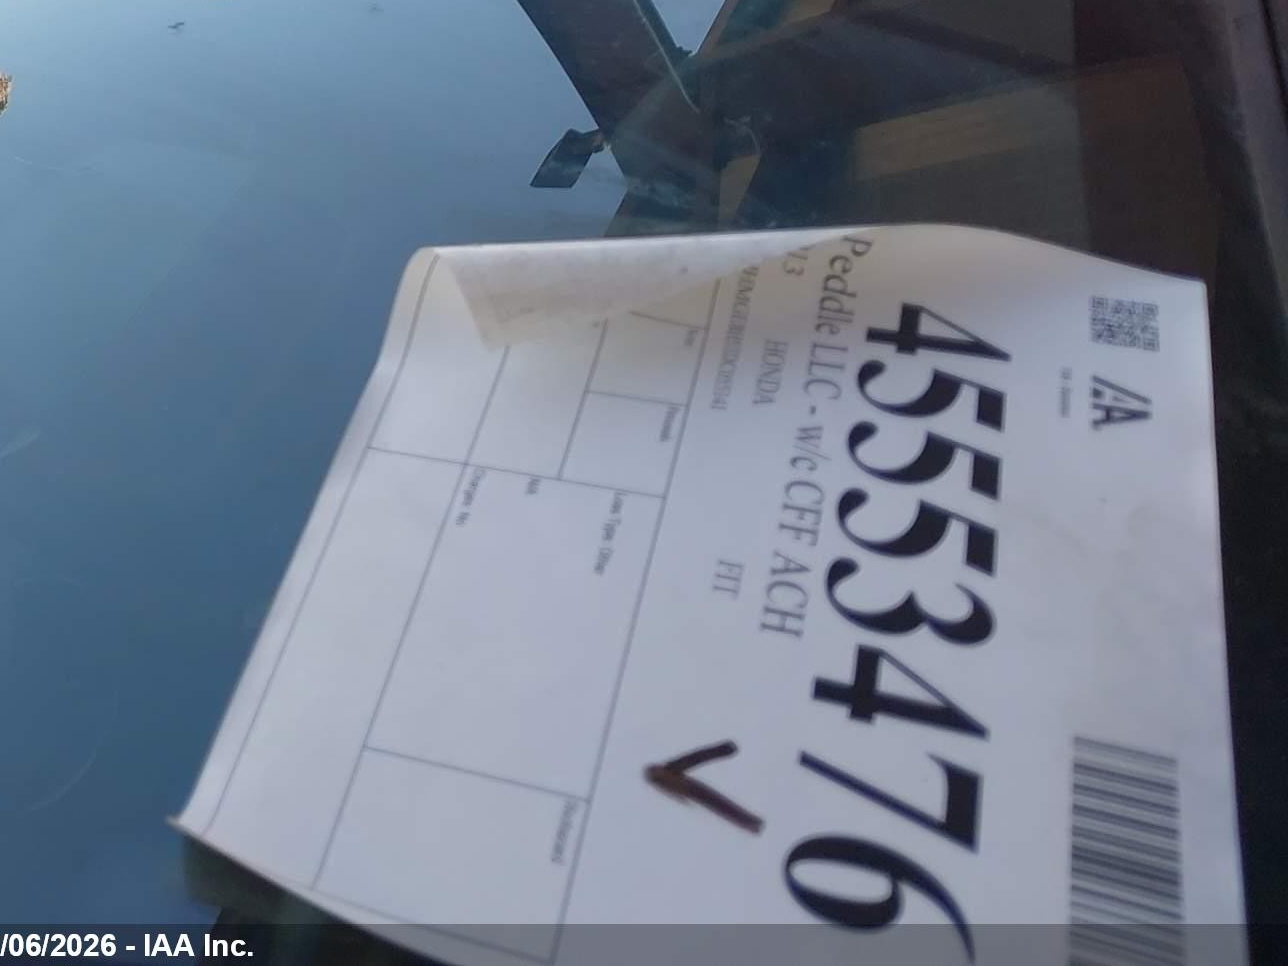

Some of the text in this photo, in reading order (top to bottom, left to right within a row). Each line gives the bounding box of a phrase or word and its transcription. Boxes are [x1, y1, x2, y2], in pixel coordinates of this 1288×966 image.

[814, 235, 874, 336] Peddle
[752, 339, 789, 405] HONDA
[803, 342, 849, 401] LLC
[789, 426, 832, 472] w/c
[778, 480, 825, 546] CFF
[713, 559, 744, 599] FIT
[760, 549, 812, 638] ACH
[783, 302, 1012, 965] 45553476
